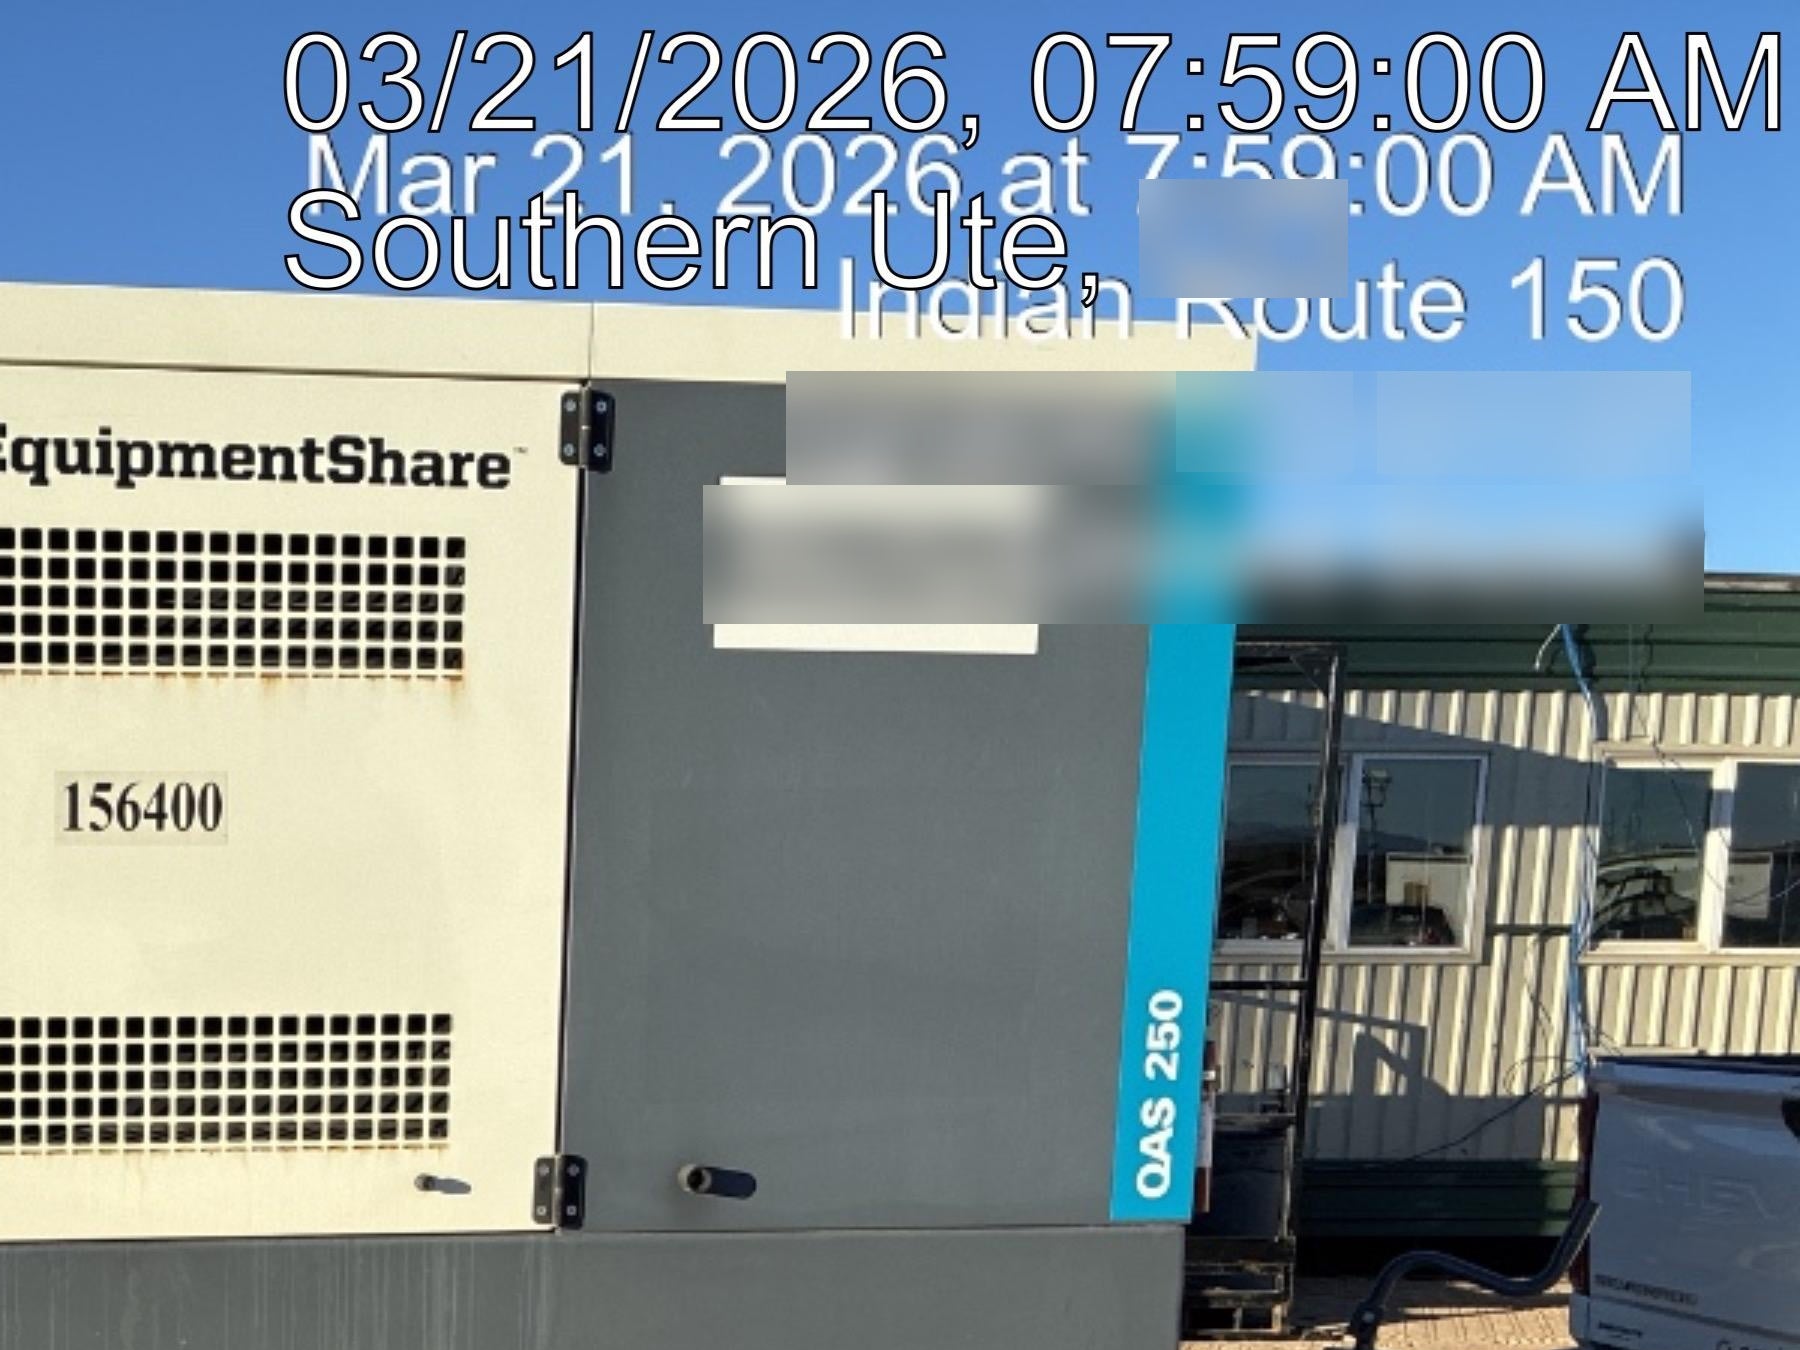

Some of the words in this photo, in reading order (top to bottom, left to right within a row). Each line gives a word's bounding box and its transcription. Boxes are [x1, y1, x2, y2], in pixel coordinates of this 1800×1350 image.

[63, 780, 223, 832] 156400
[1144, 988, 1184, 1082] 250
[1135, 1096, 1177, 1200] QAS
